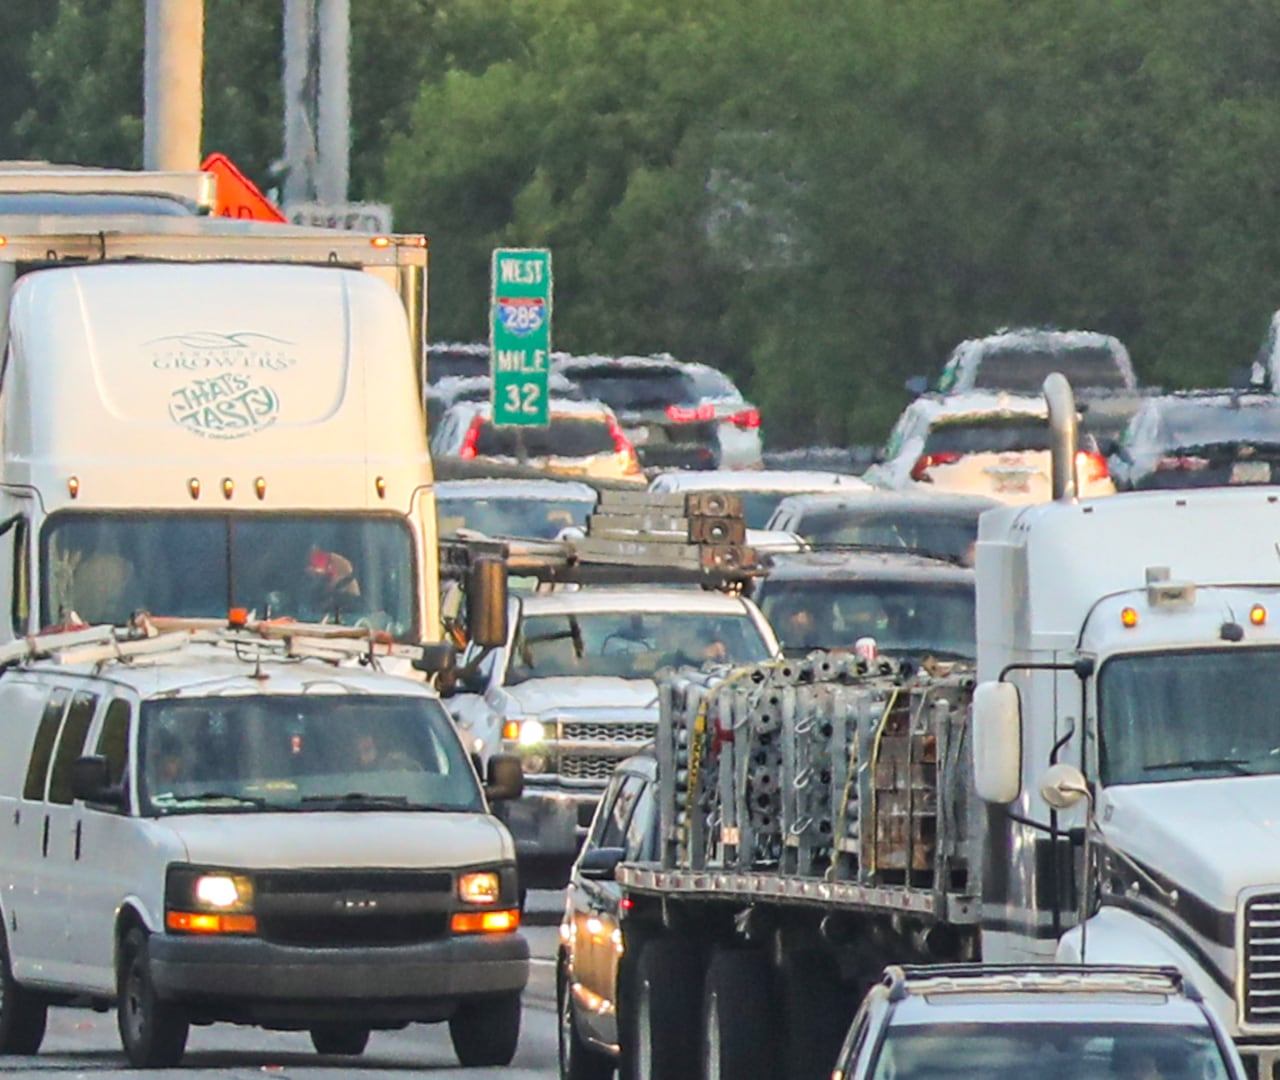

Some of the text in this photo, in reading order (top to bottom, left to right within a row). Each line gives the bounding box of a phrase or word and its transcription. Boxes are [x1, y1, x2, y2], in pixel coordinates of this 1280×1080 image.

[500, 259, 544, 284] WEST
[507, 305, 541, 329] 285
[498, 350, 546, 374] MILE
[503, 383, 541, 414] 32
